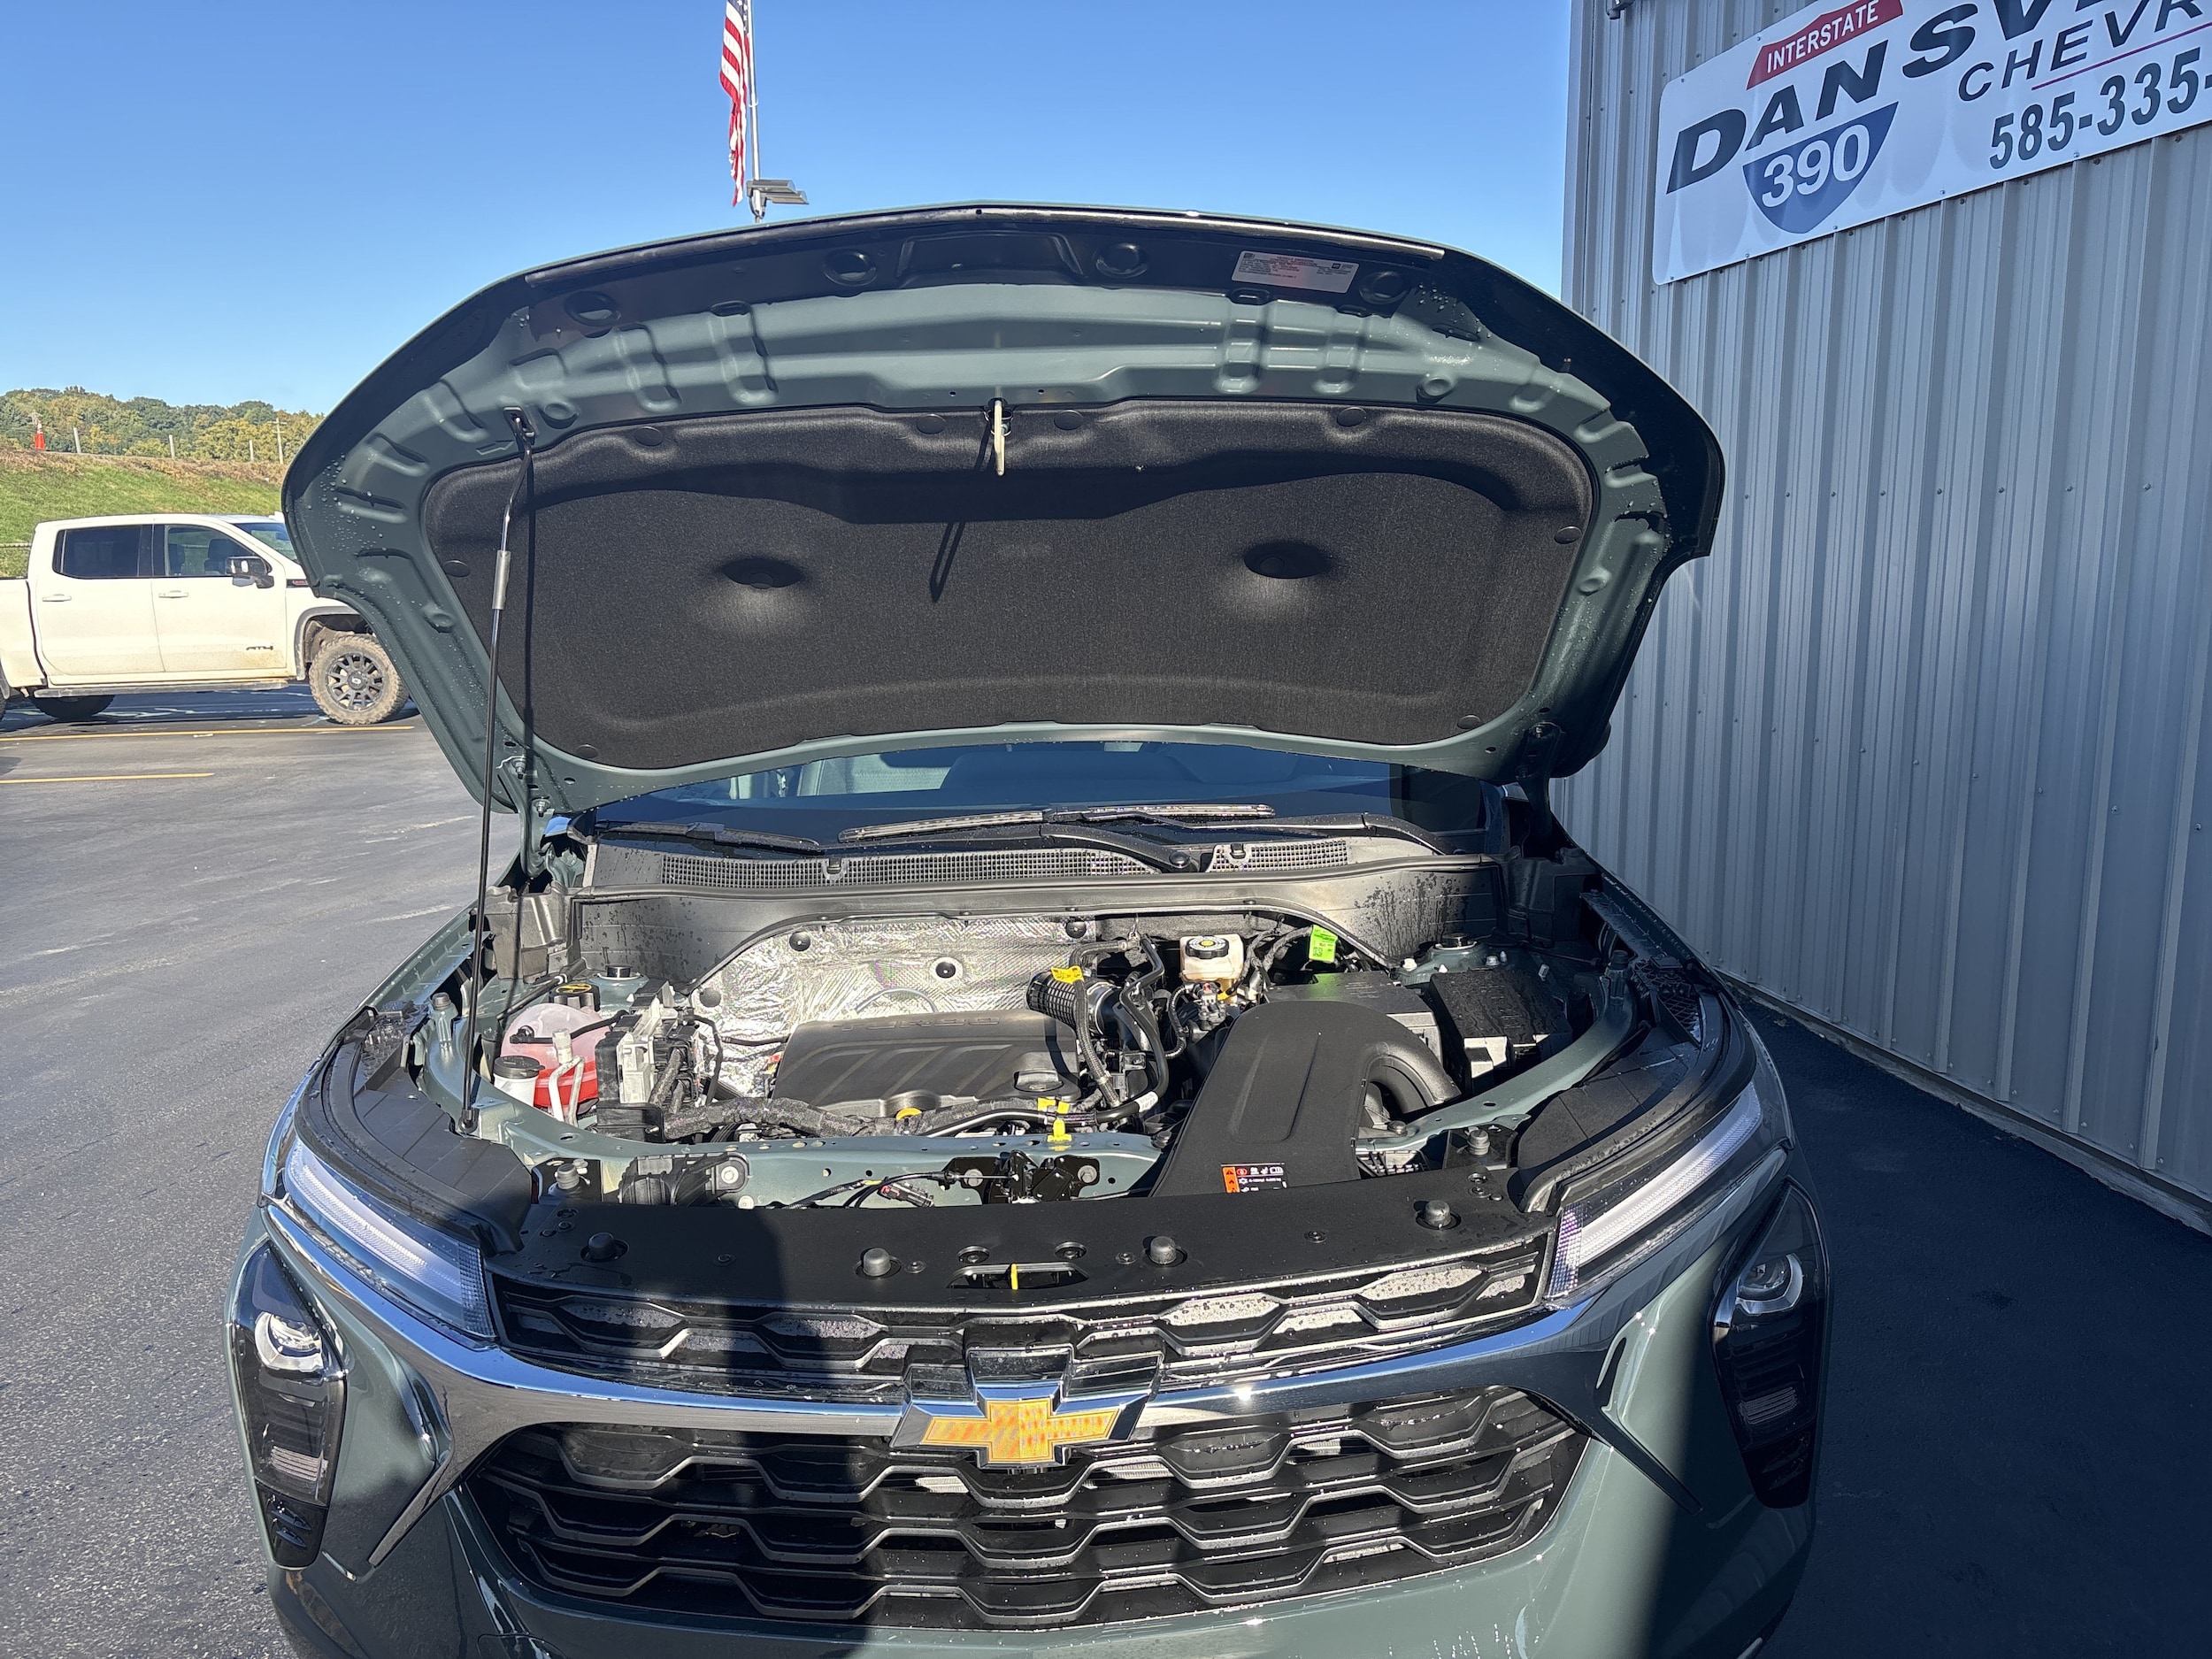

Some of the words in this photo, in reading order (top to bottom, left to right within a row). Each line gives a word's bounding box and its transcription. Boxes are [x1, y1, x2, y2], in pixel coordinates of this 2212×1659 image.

[1767, 0, 1879, 73] INTERSTATE
[1958, 0, 2203, 102] CHEVR
[1666, 0, 2105, 195] DANSV
[1989, 46, 2212, 170] 585-335-
[1762, 124, 1870, 208] 390
[832, 1016, 1001, 1033] TURBO
